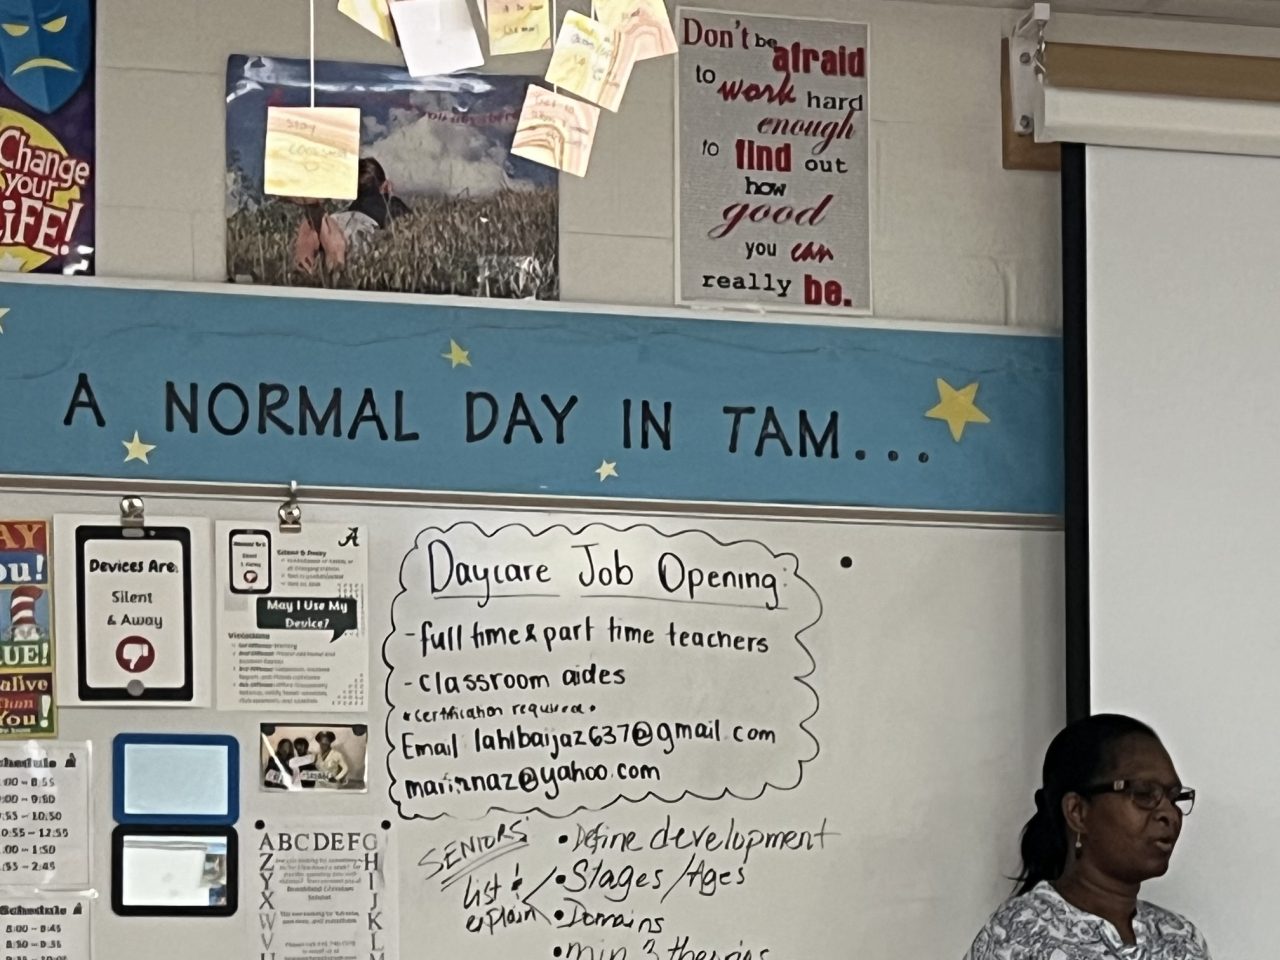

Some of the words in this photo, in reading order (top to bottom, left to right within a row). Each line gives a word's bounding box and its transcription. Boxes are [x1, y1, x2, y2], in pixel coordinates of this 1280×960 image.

[682, 17, 750, 51] Don't
[754, 33, 778, 50] be
[773, 43, 865, 78] afraid
[696, 65, 716, 85] to
[717, 74, 797, 106] work
[807, 91, 864, 112] hard
[757, 111, 857, 154] enough
[0, 129, 90, 188] Change
[702, 139, 720, 157] to
[735, 139, 793, 173] find
[805, 157, 849, 174] out
[5, 172, 59, 201] your
[745, 177, 786, 197] how
[0, 197, 84, 256] iFE!
[708, 194, 834, 239] good
[745, 240, 777, 260] you
[790, 241, 834, 262] can
[702, 273, 792, 298] really
[803, 275, 853, 307] be.
[63, 372, 106, 428] A
[165, 380, 419, 442] NORMAL
[465, 391, 578, 444] DAY
[622, 398, 673, 451] IN
[89, 557, 144, 574] Devices
[428, 539, 551, 608] Daycare
[571, 543, 634, 588] Job
[112, 590, 153, 604] Silent
[267, 600, 293, 614] May
[296, 600, 301, 611] I
[304, 600, 325, 612] Use
[329, 600, 348, 614] My
[107, 614, 117, 626] &
[120, 613, 163, 629] Away
[285, 618, 330, 630] Device?
[471, 620, 522, 648] time
[544, 616, 595, 651] part
[608, 615, 655, 645] time
[668, 621, 770, 654] teachers
[562, 663, 626, 686] aides
[402, 730, 458, 760] Email
[573, 823, 643, 855] Define
[650, 815, 841, 866] development
[562, 897, 664, 935] Domains
